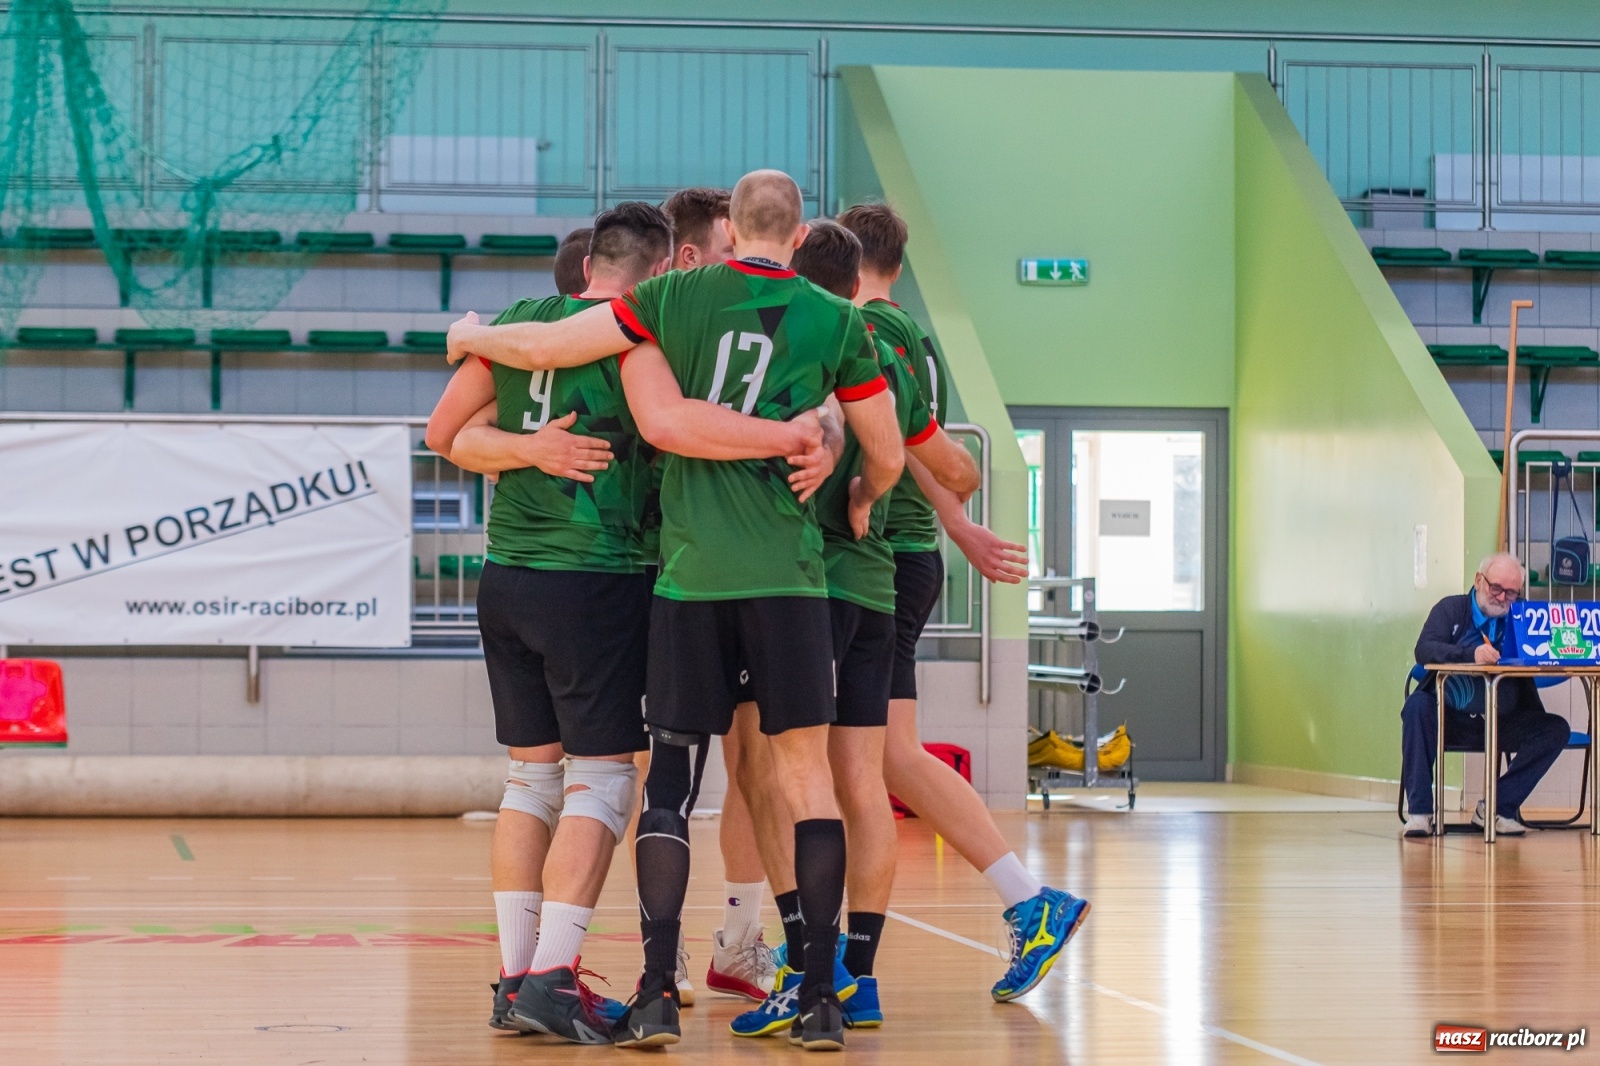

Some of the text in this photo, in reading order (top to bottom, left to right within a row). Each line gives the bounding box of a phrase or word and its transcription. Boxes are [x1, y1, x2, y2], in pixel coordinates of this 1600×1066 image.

[707, 331, 773, 416] 13
[522, 369, 555, 431] 9
[72, 534, 110, 569] W
[124, 460, 372, 556] PORZĄDKU!
[125, 597, 377, 621] www.osir-raciborz.pl
[1526, 608, 1550, 636] 22
[1580, 608, 1600, 636] 20
[783, 911, 802, 923] adid
